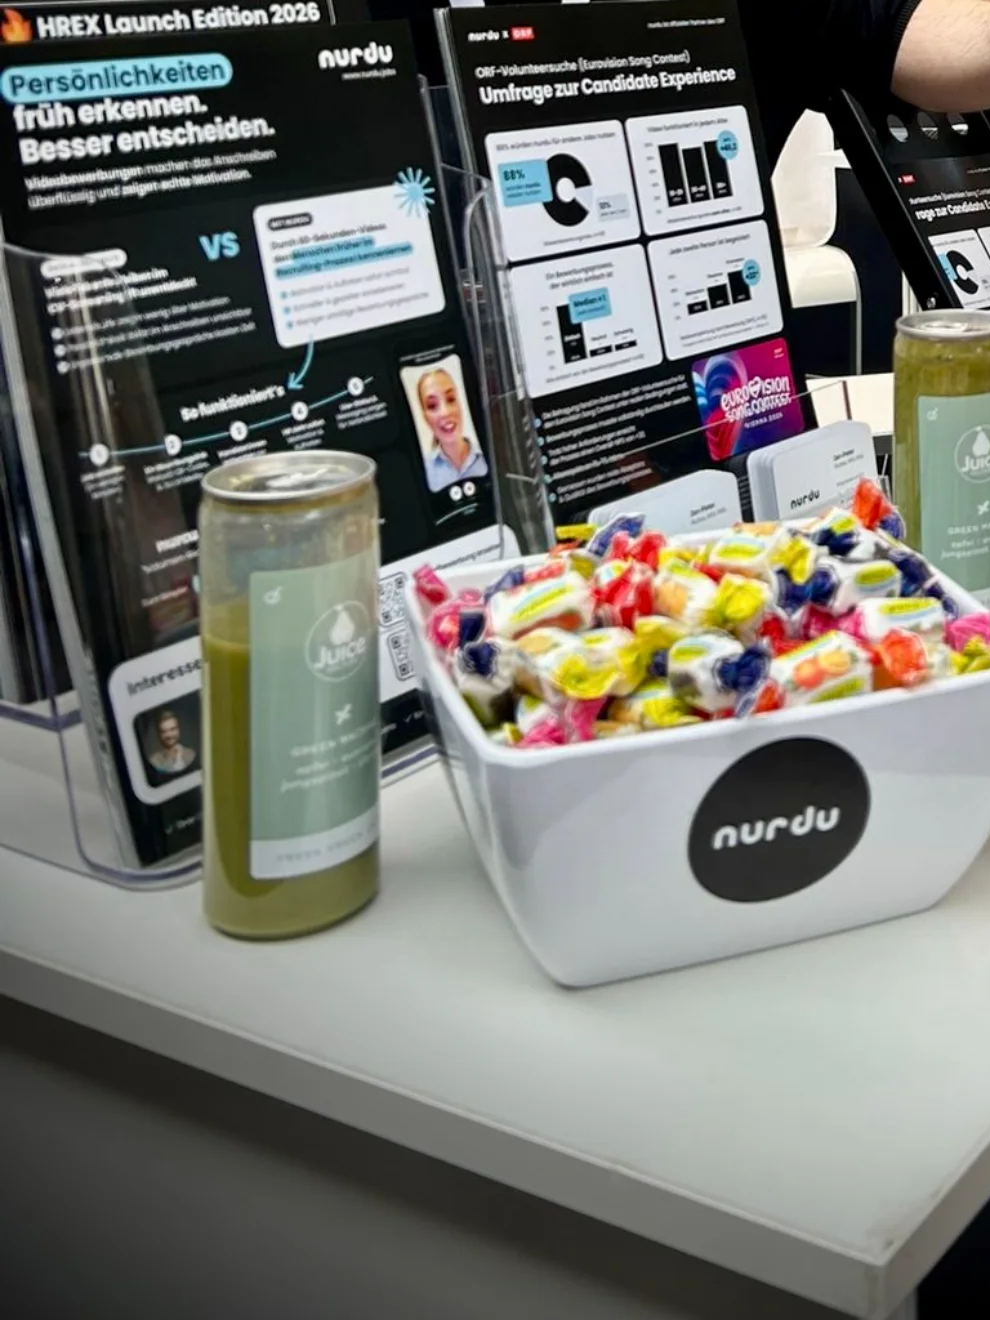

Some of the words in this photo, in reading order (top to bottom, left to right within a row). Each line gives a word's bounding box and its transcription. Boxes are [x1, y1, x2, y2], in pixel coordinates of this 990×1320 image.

[37, 13, 102, 38] HREX
[104, 8, 190, 35] Launch
[193, 5, 268, 30] Edition
[270, 2, 320, 24] 2026
[468, 30, 500, 41] nurdu
[318, 41, 393, 69] nurdu
[10, 59, 225, 96] Persönlichkeiten
[479, 82, 553, 105] Umfrage
[554, 82, 579, 97] zur
[580, 72, 659, 96] Candidate
[661, 66, 737, 91] Experience
[13, 101, 75, 132] früh
[78, 94, 208, 127] erkennen.
[18, 133, 114, 165] Besser
[117, 115, 275, 150] entscheiden.
[503, 168, 525, 181] 88%
[199, 231, 241, 261] VS
[790, 490, 820, 509] nurdu
[314, 637, 367, 670] Juice
[711, 805, 840, 850] nurdu
